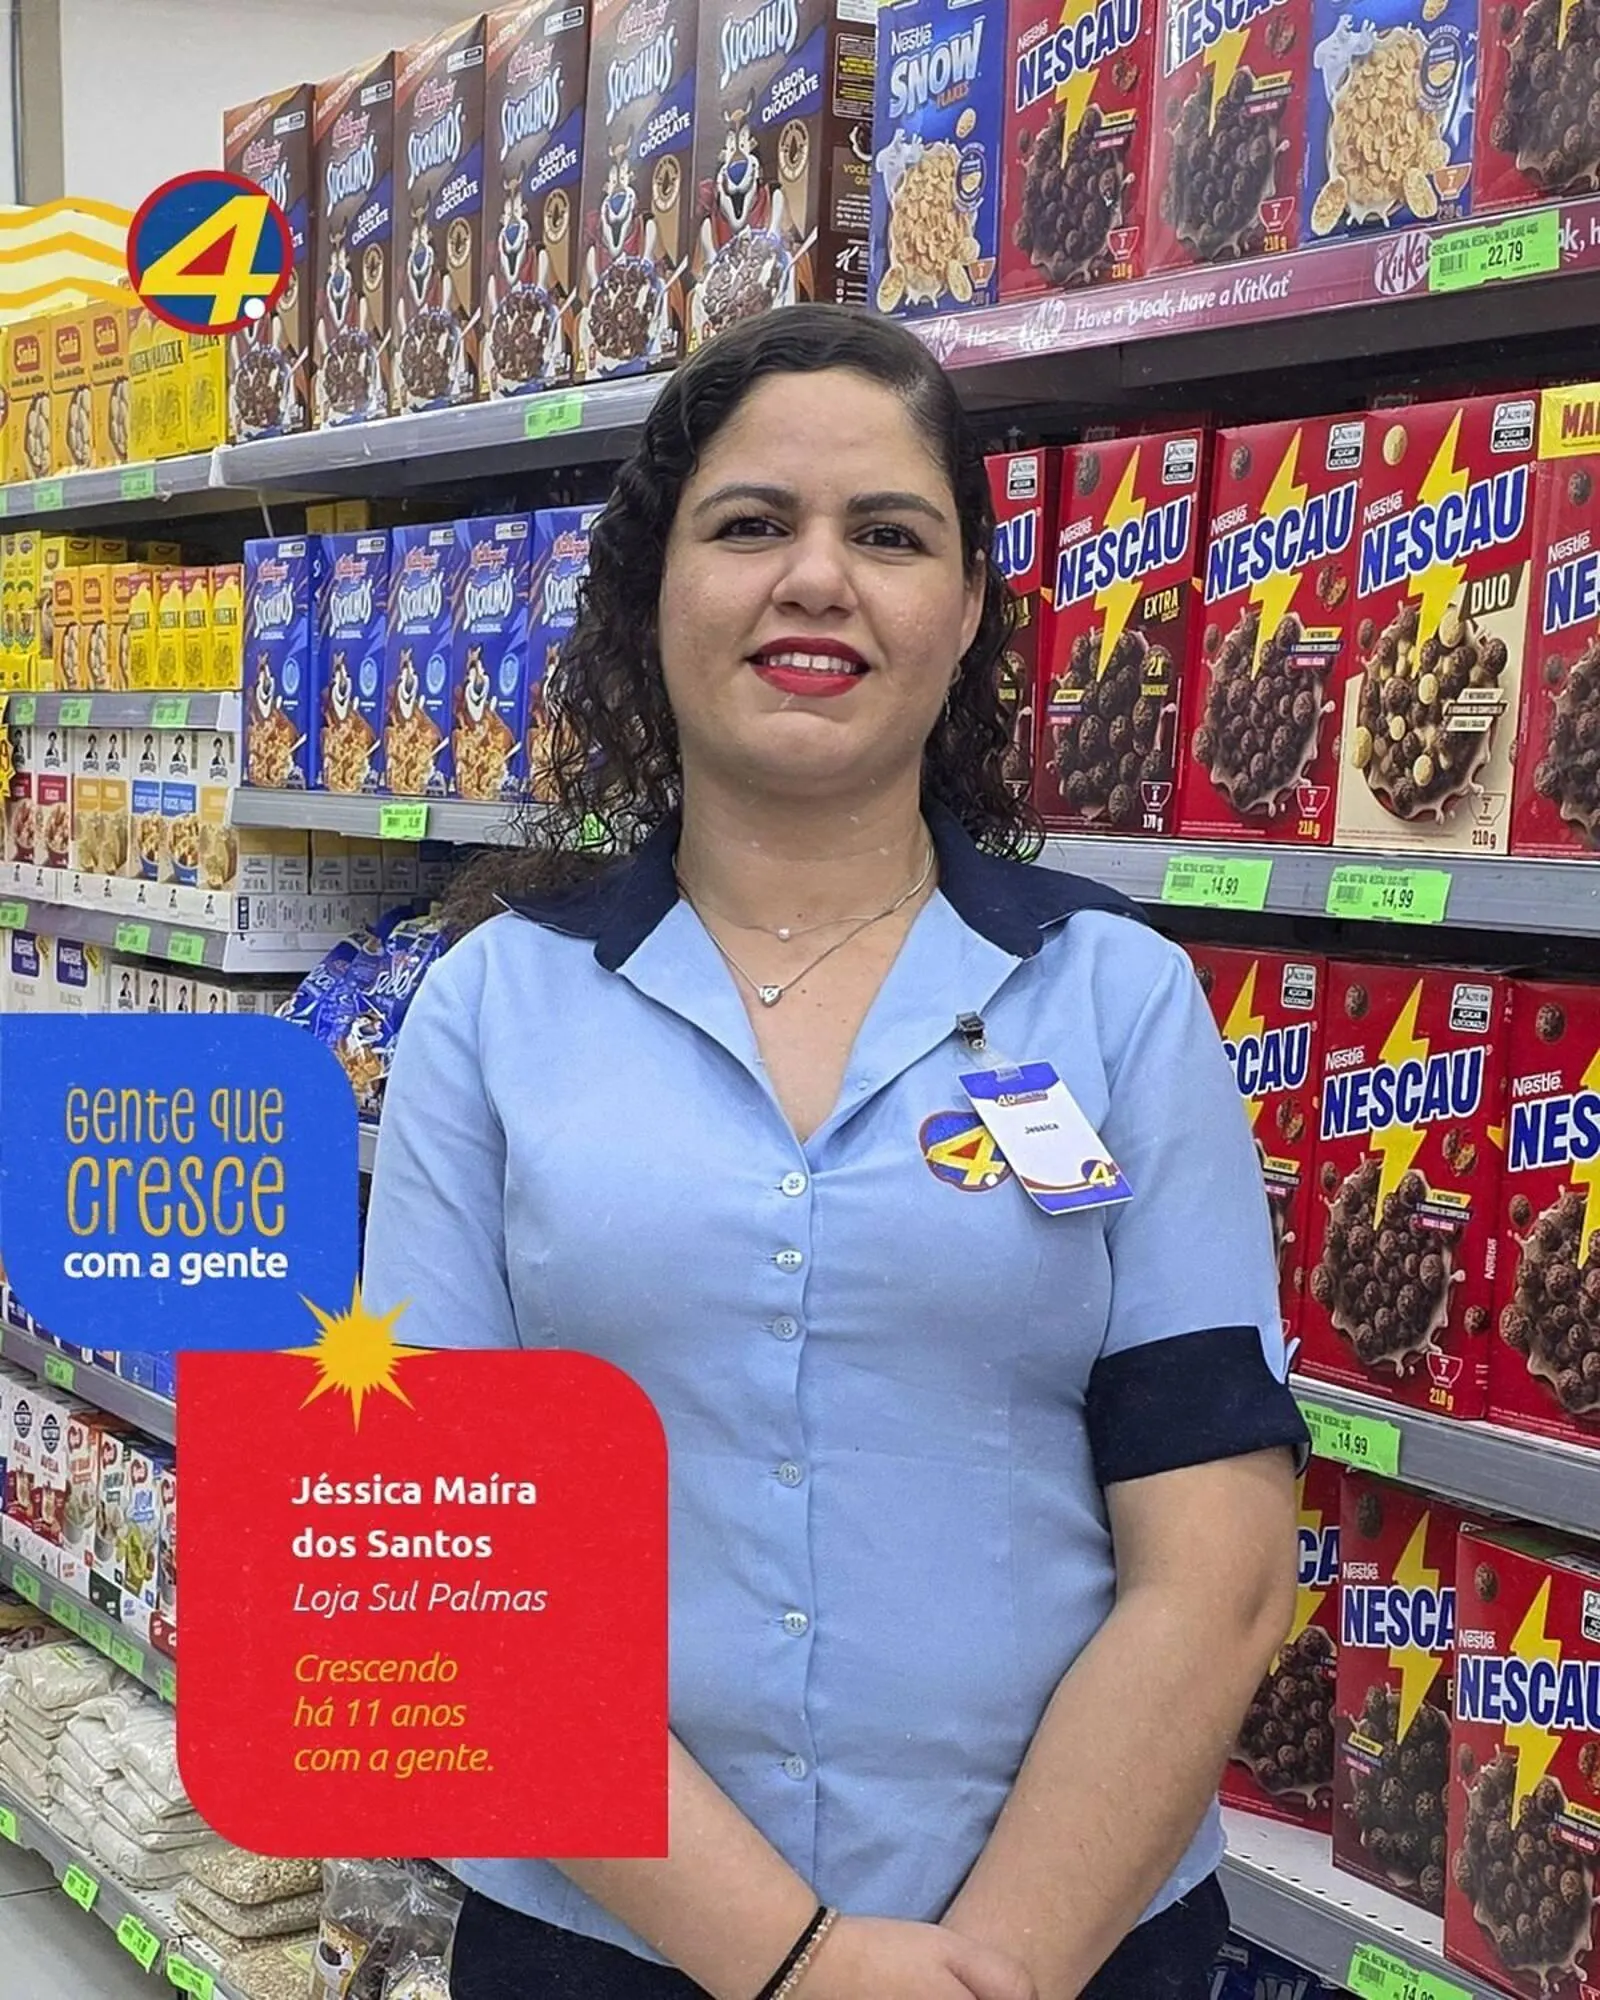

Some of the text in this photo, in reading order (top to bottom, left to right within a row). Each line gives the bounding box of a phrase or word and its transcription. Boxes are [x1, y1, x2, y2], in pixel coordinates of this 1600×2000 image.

[889, 15, 985, 118] SNOW
[1015, 0, 1143, 113] NESCAU
[762, 74, 819, 122] CHOCOLATE
[771, 68, 805, 100] SABOR
[639, 112, 691, 157] CHOCOLATE
[648, 106, 678, 137] SABOR
[531, 152, 577, 192] CHOCOLATE
[538, 144, 565, 172] SABOR
[435, 180, 479, 221] CHOCOLATE
[442, 175, 467, 201] SABOR
[1488, 240, 1523, 267] 22,79
[1074, 307, 1111, 330] Have
[1178, 289, 1215, 314] have
[1220, 292, 1230, 306] a
[1232, 275, 1290, 305] KitKat
[1054, 495, 1192, 612] NESCAU
[1205, 481, 1358, 606] NESCAU
[1358, 465, 1530, 600] NESCAU
[1144, 587, 1178, 620] EXTRA
[1470, 572, 1510, 615] DUO
[1382, 888, 1414, 910] 14,99
[1320, 1045, 1485, 1141] NESCAU
[1341, 1585, 1456, 1651] NESCA
